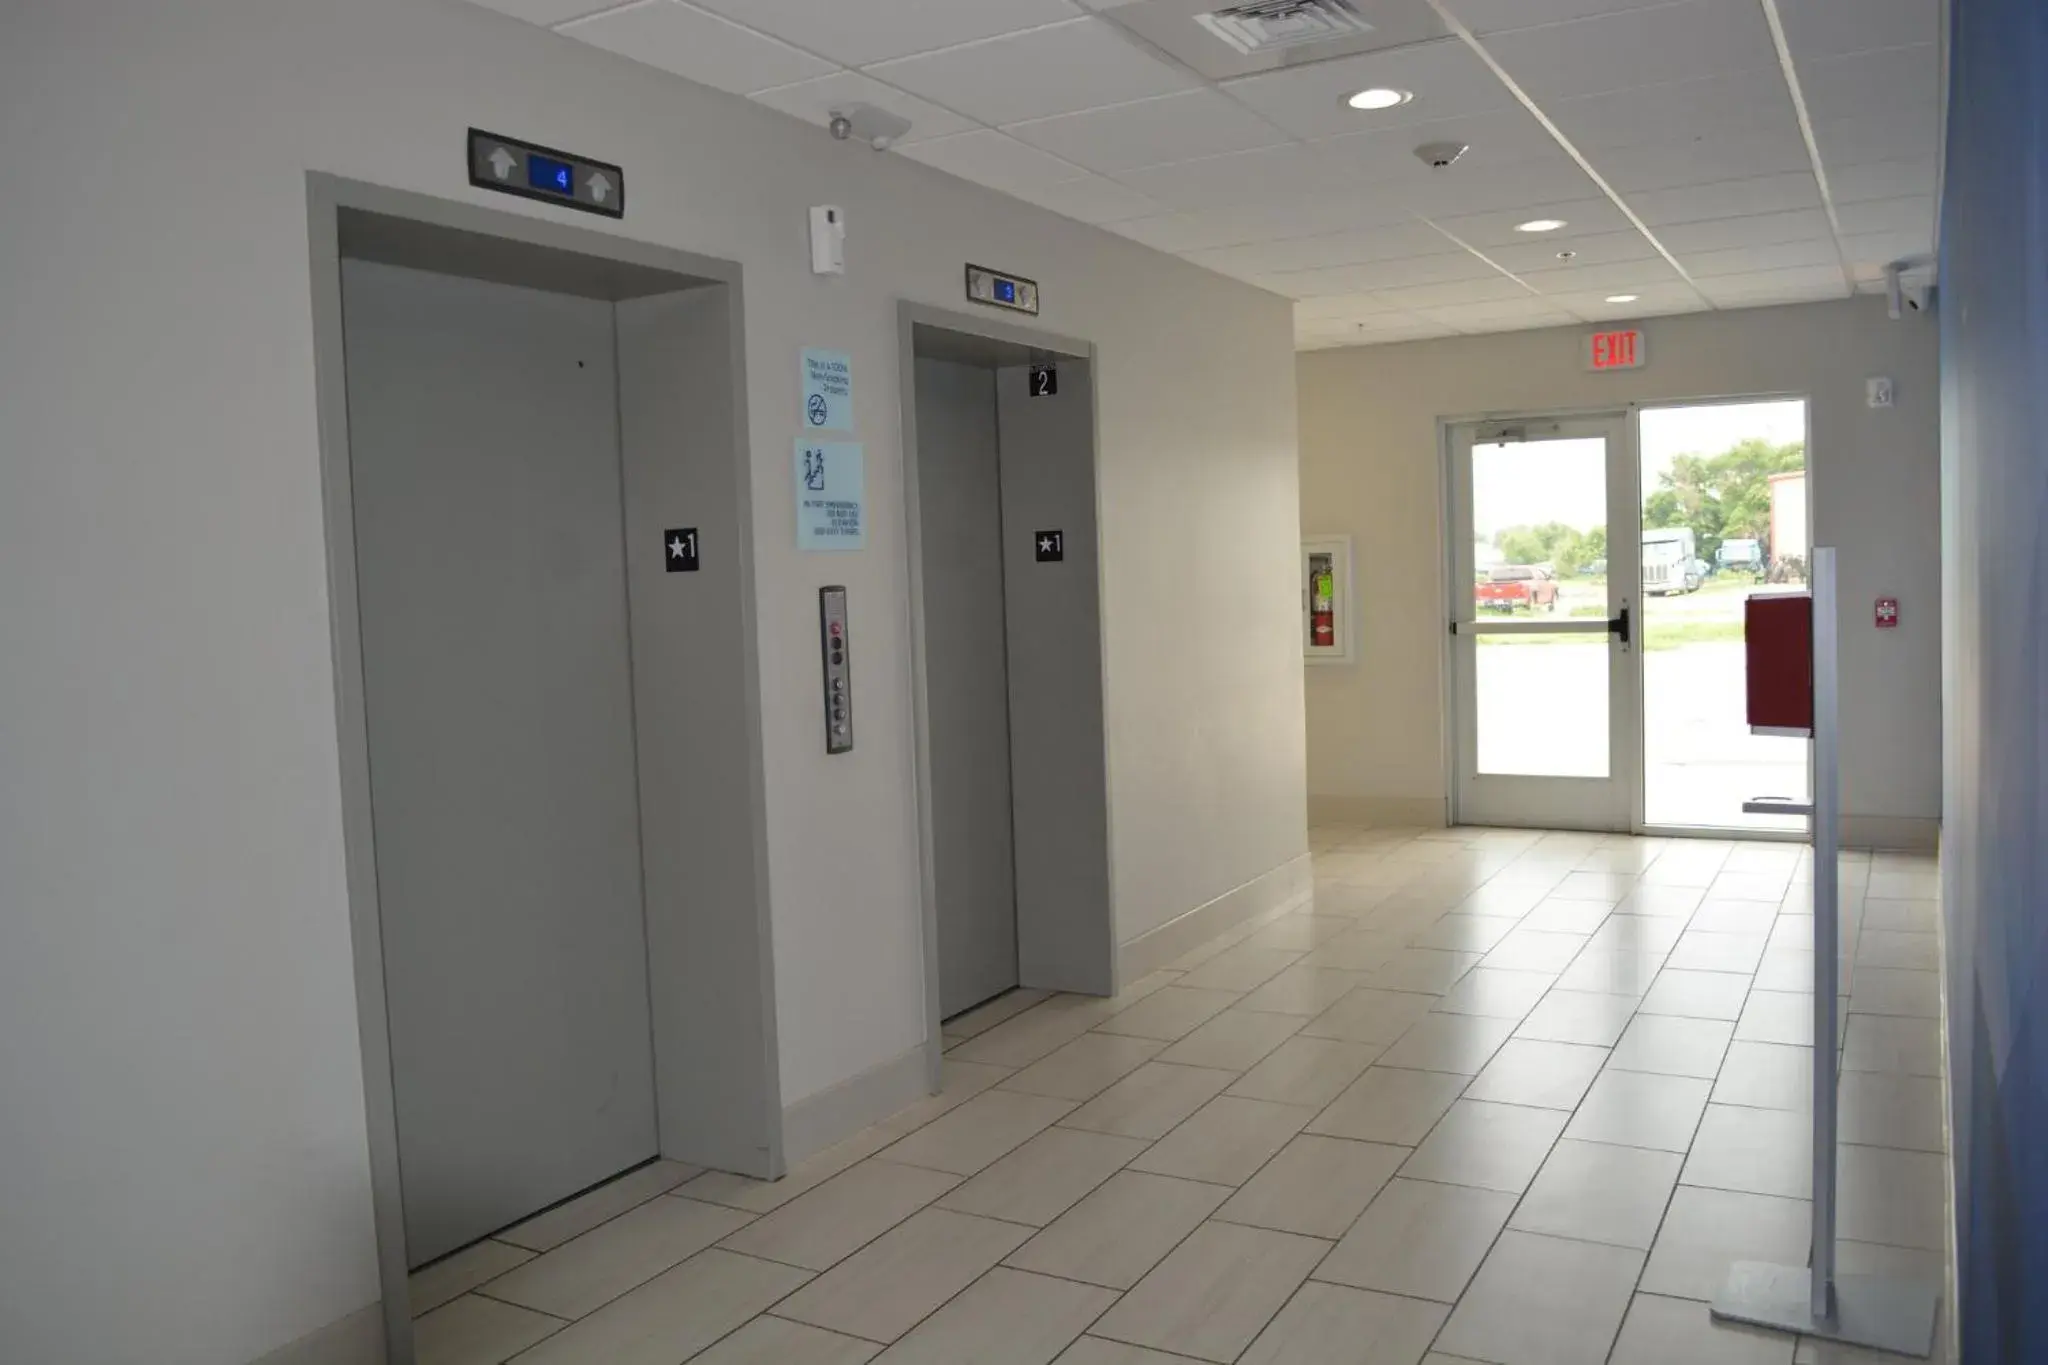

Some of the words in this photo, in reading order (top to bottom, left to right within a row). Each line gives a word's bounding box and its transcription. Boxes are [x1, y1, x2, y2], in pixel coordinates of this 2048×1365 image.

[556, 169, 568, 188] 4
[1593, 331, 1637, 368] EXIT
[1038, 371, 1049, 395] 2
